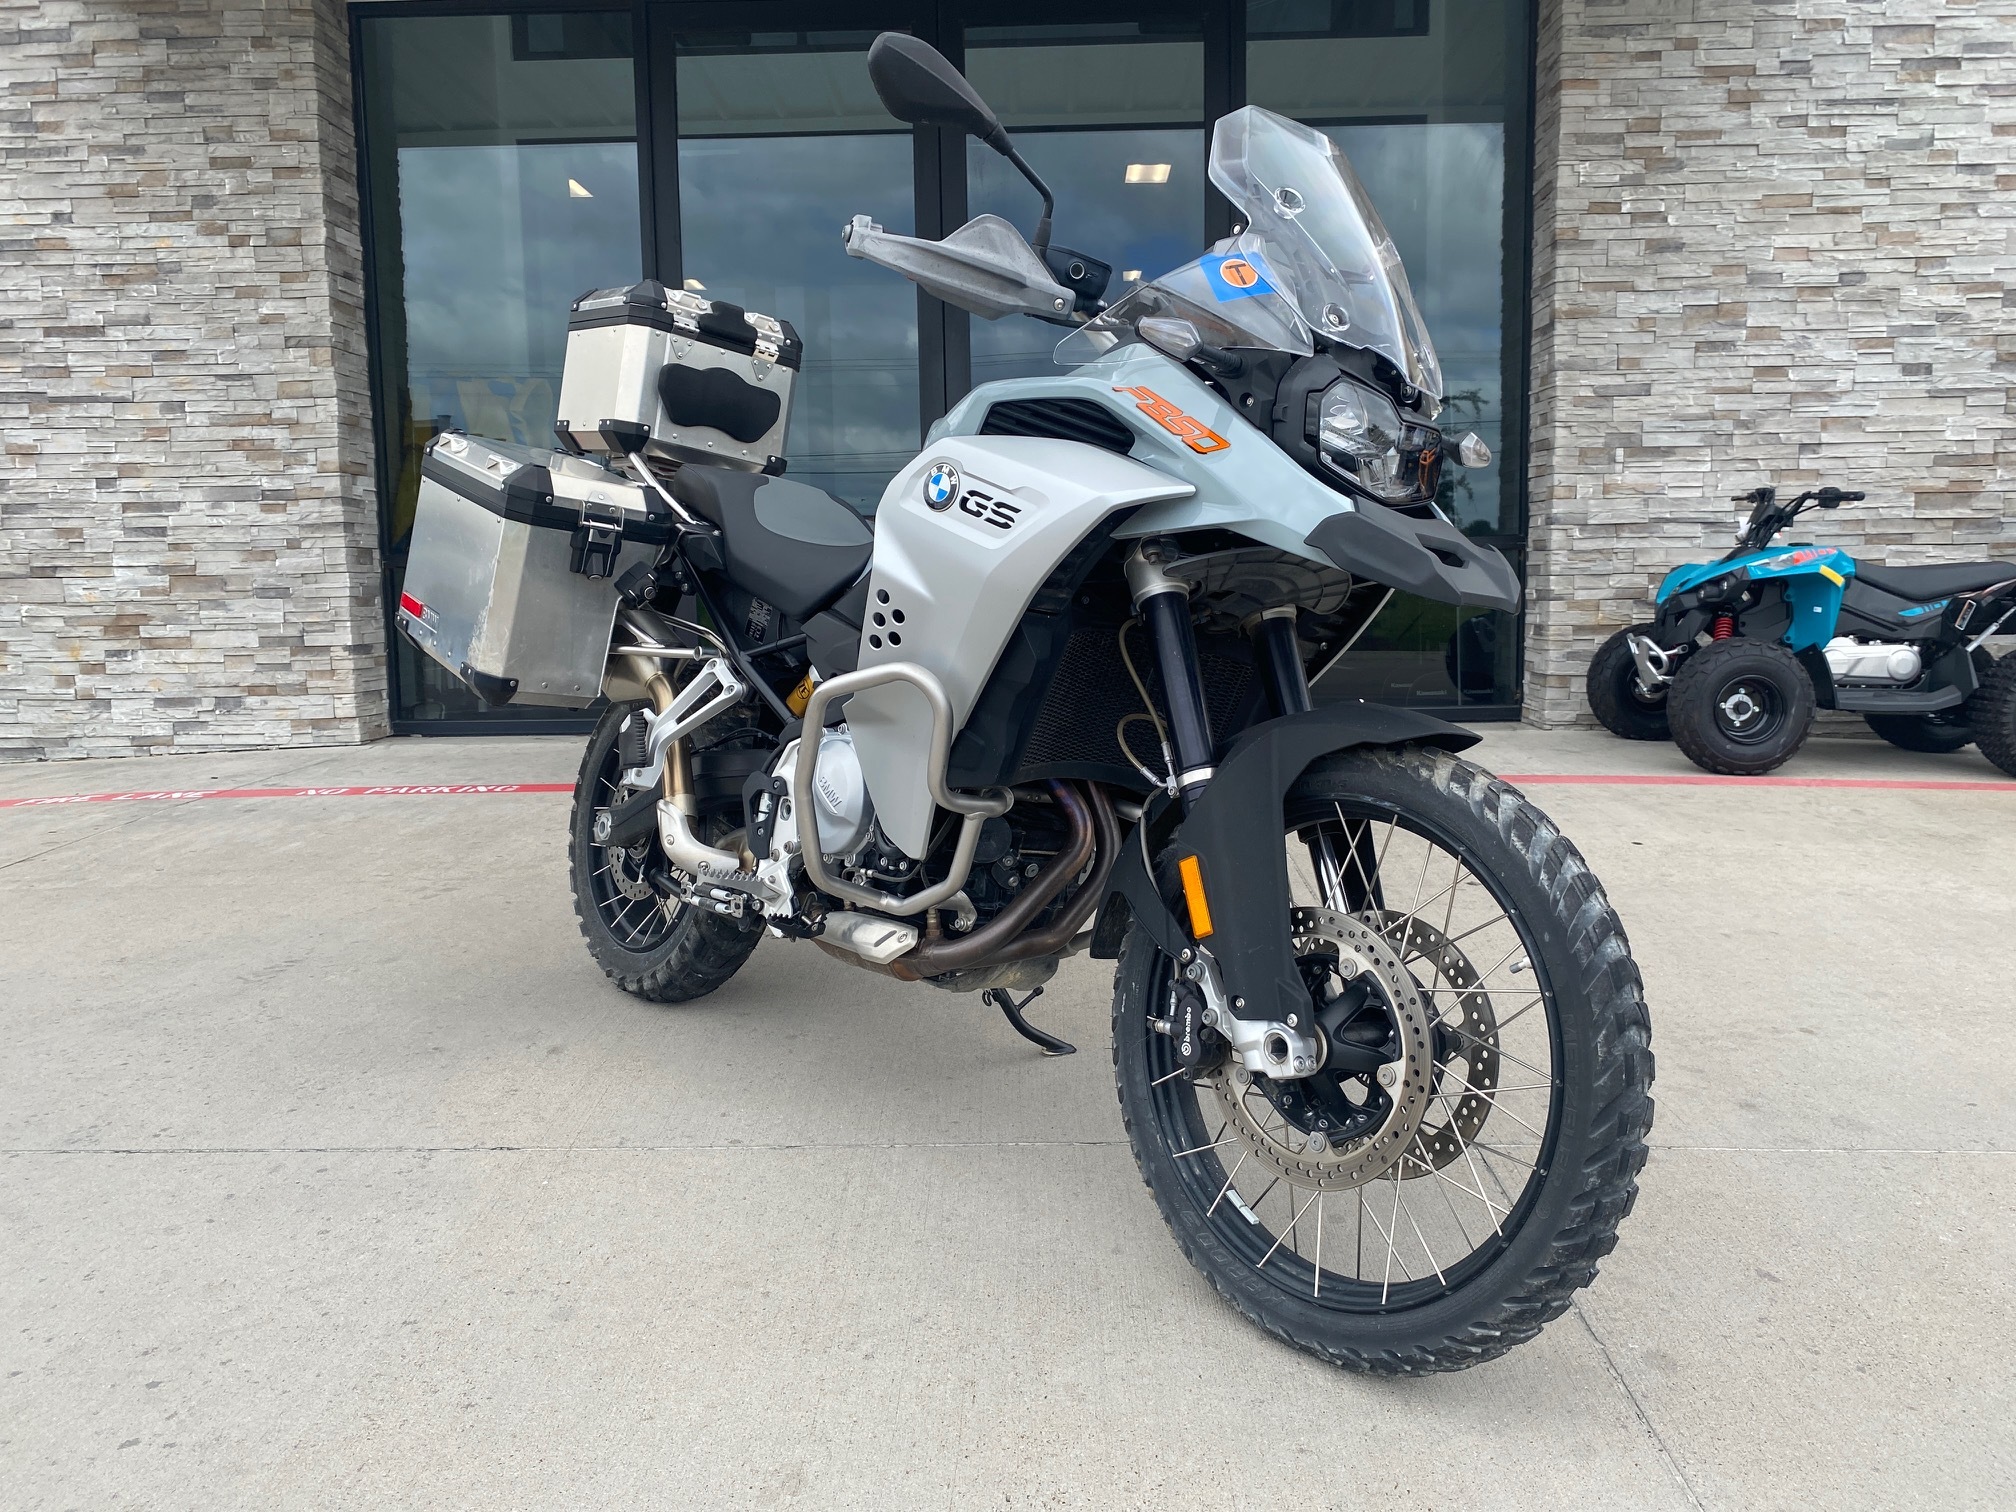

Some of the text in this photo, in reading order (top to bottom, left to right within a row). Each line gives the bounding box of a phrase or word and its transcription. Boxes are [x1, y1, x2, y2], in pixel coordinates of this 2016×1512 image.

[1225, 263, 1247, 285] T
[1111, 385, 1231, 454] F850
[930, 464, 958, 485] BMW
[959, 489, 1022, 529] GS
[111, 791, 219, 801] LANE
[295, 785, 520, 796] NO PARKING
[820, 776, 842, 808] BMW
[1183, 1006, 1192, 1043] brembo
[1551, 1012, 1580, 1187] METZELER
